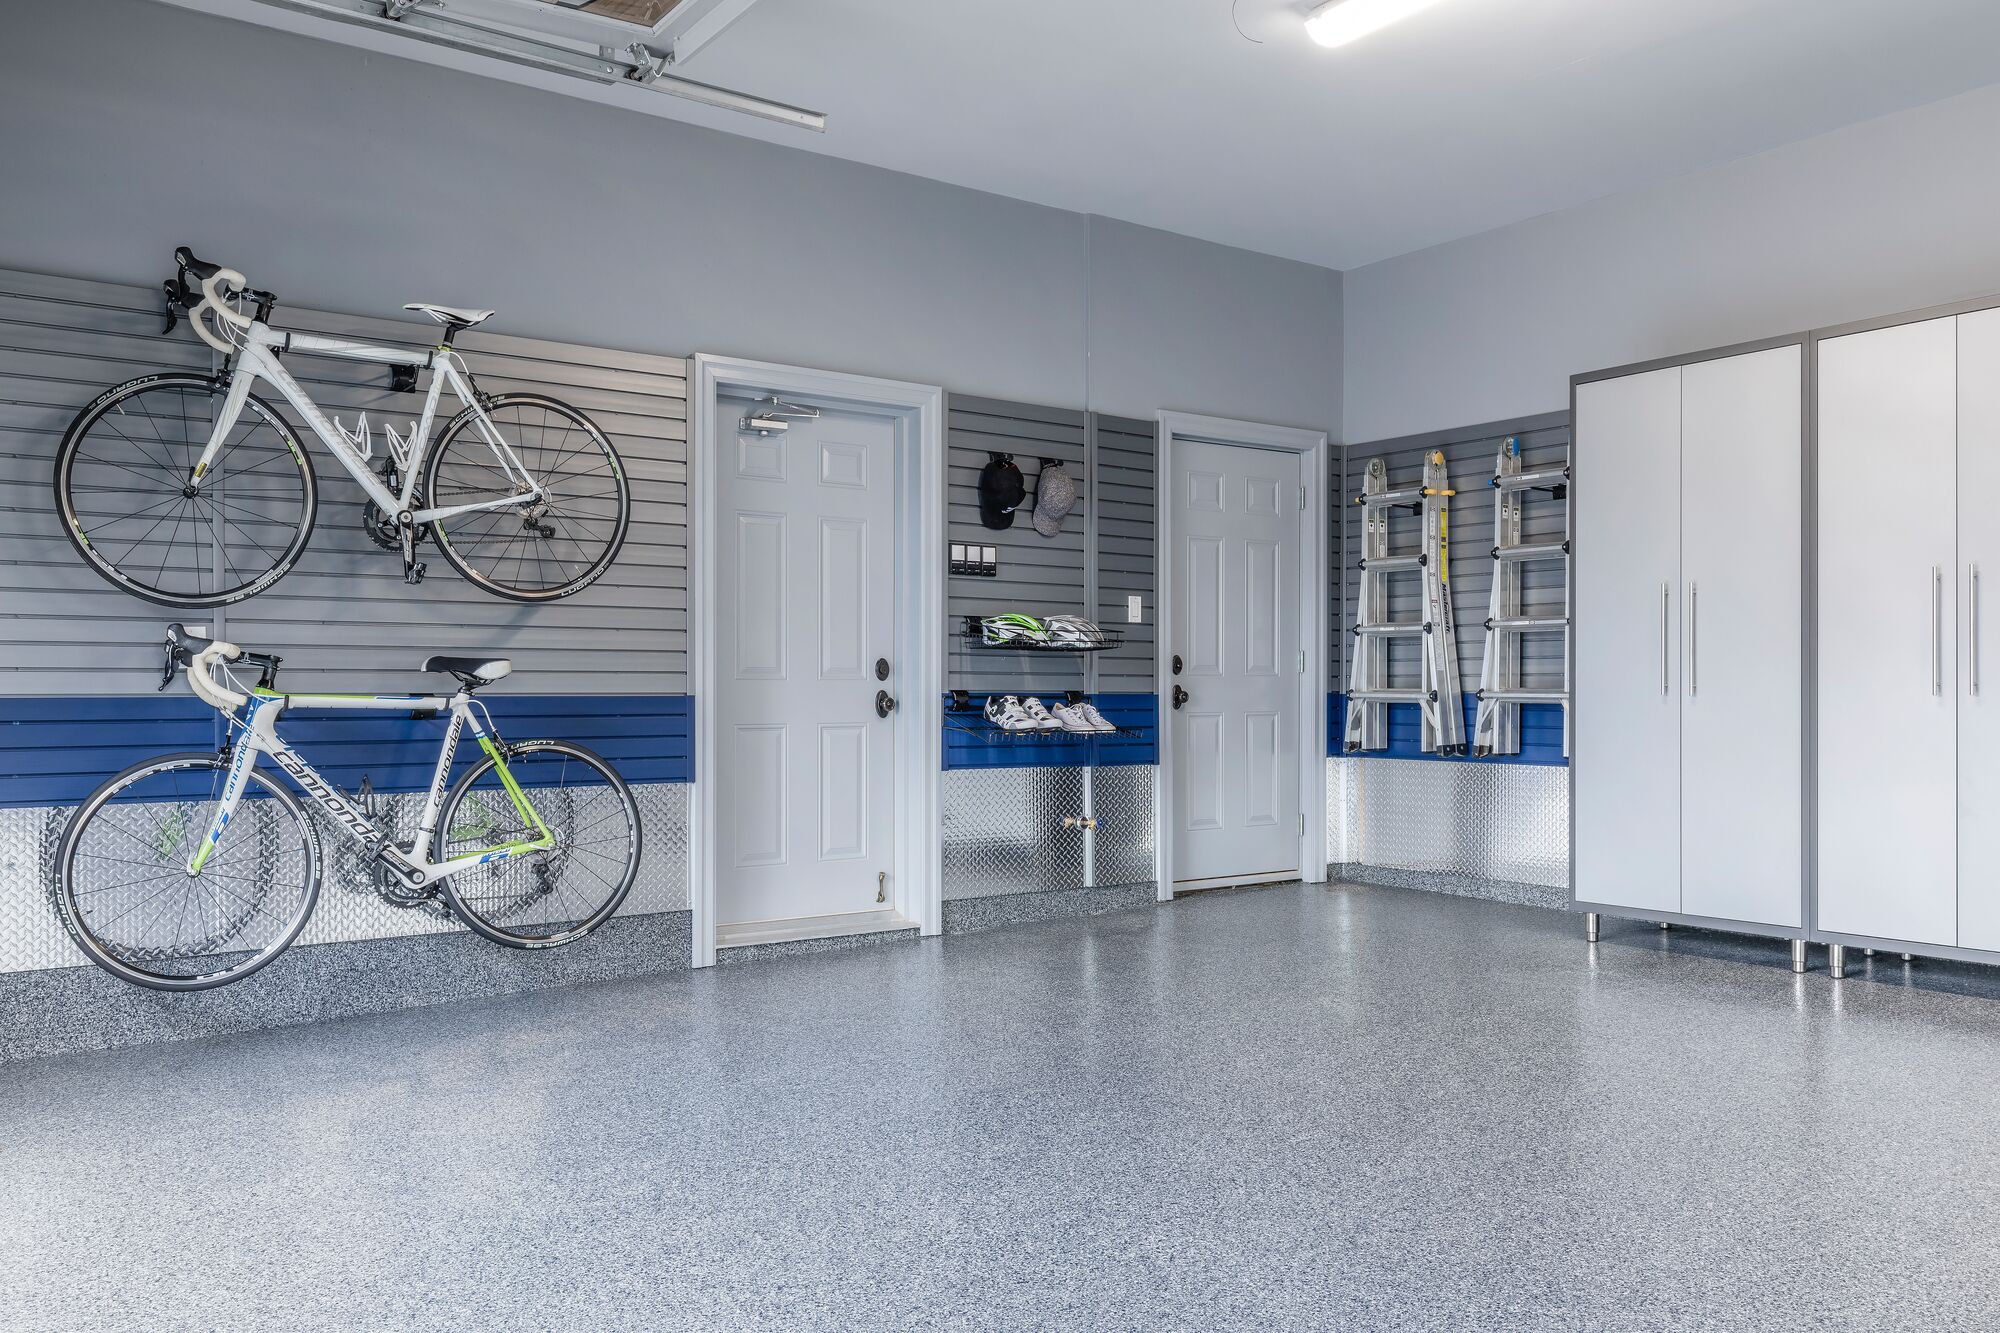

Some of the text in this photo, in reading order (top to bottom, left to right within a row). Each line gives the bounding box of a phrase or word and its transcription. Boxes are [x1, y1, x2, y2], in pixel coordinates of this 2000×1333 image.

[96, 376, 158, 404] LUGANO
[433, 714, 463, 808] cannondale
[510, 740, 555, 749] LUGAN
[273, 751, 381, 845] cannonda
[300, 810, 322, 880] SCHWALBE
[55, 873, 76, 934] LUGANO
